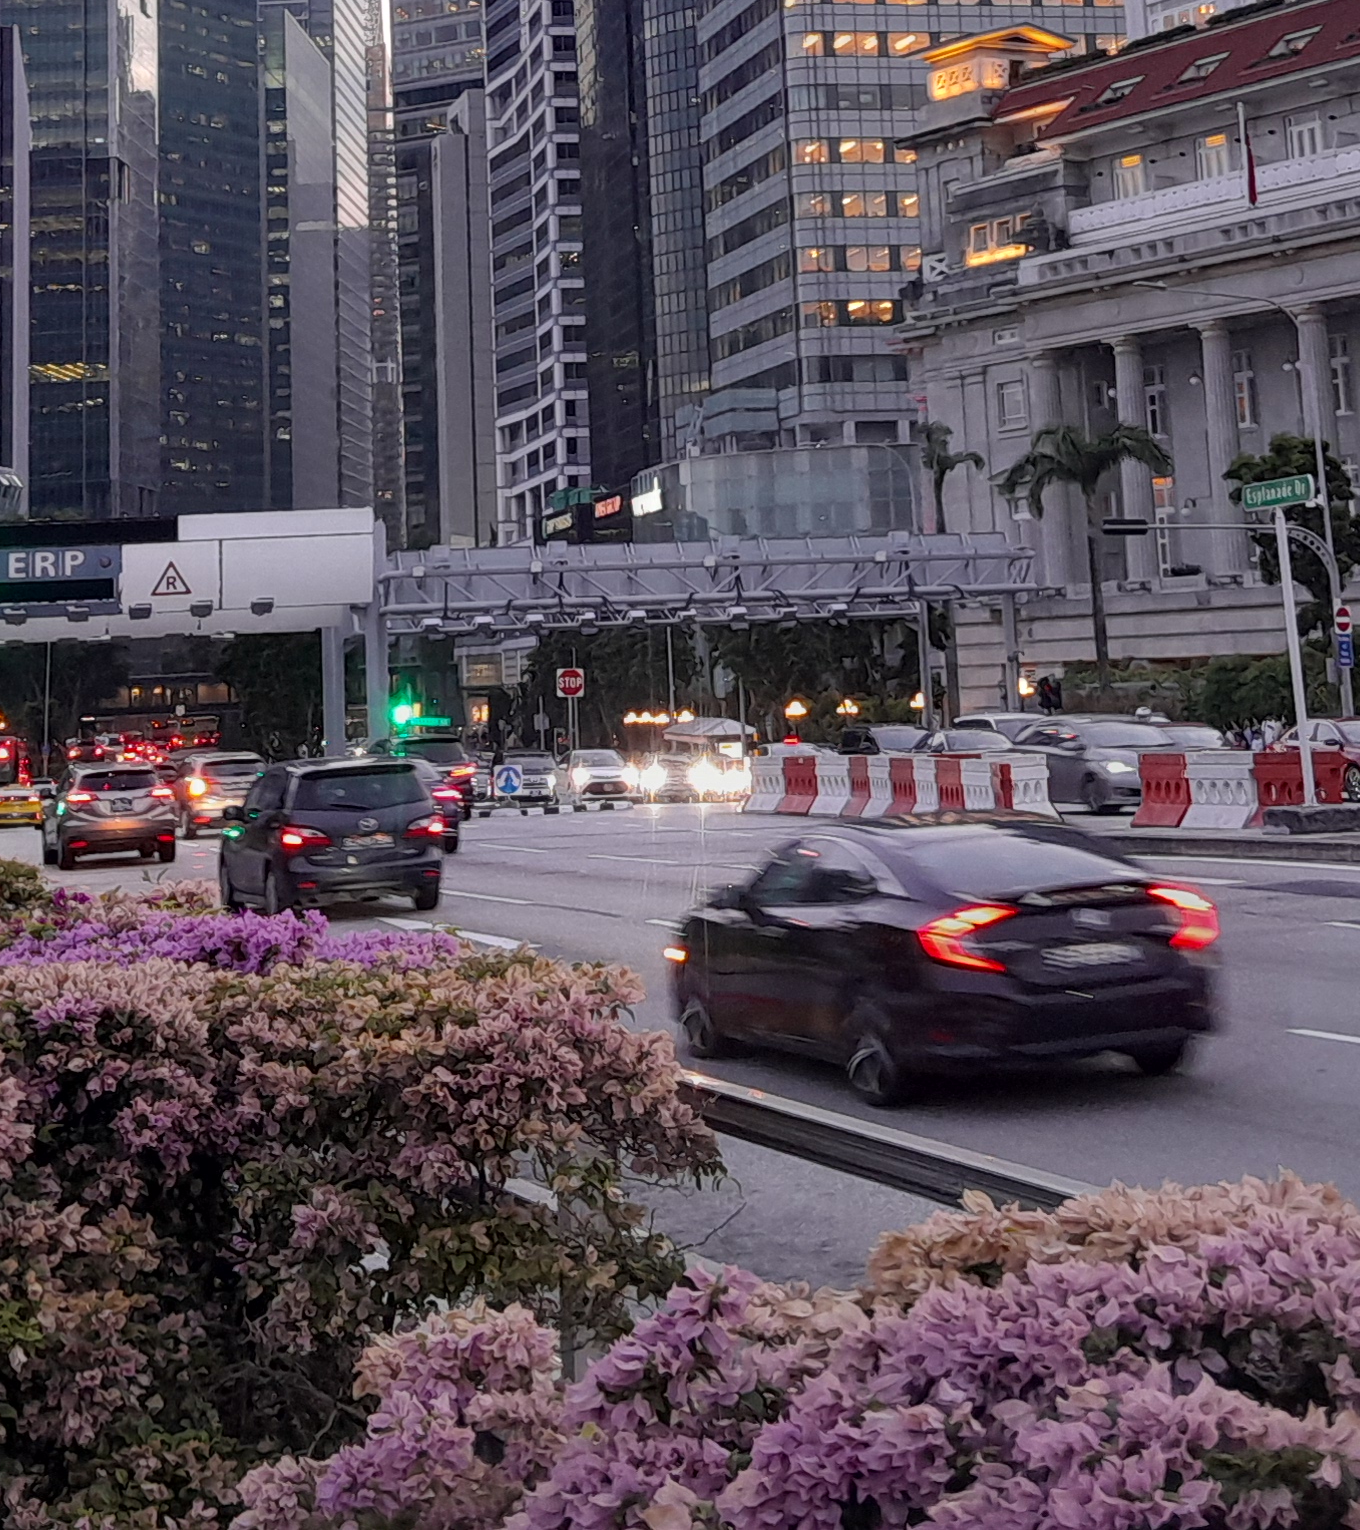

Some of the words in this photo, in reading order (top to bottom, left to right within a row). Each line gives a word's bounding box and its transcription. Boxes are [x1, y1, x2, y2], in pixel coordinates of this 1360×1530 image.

[1245, 482, 1293, 506] Esplanade
[8, 550, 86, 579] ERP
[165, 576, 178, 591] R
[558, 676, 583, 689] STOP
